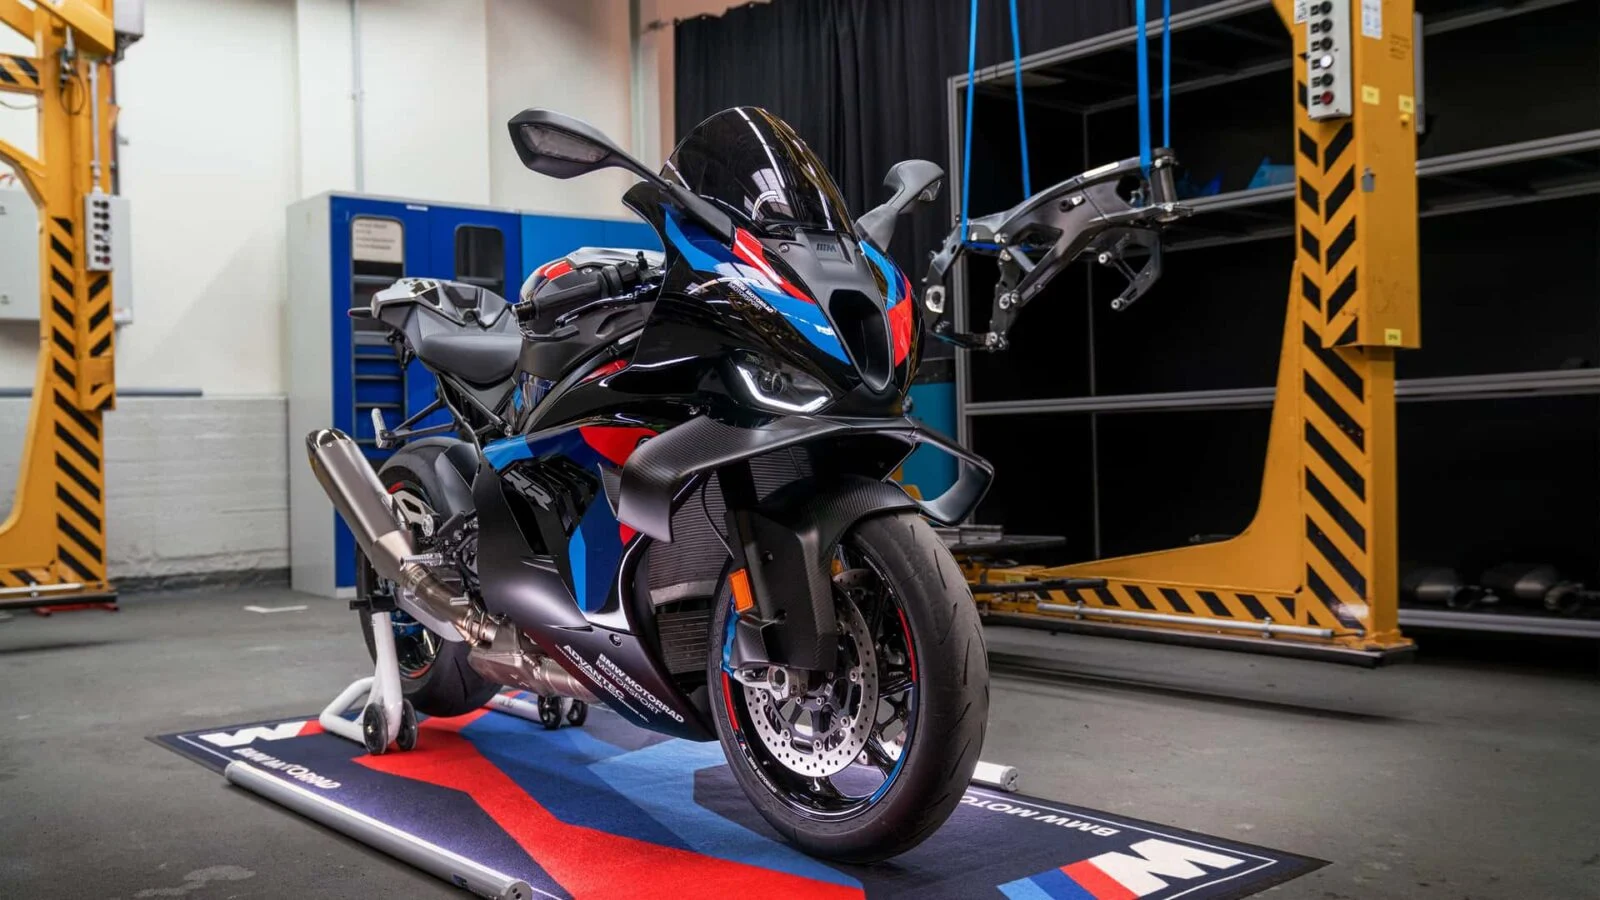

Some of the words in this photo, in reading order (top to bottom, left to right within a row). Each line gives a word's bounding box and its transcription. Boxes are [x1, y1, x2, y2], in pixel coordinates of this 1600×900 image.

[503, 469, 552, 511] RR
[563, 644, 625, 700] ADVANTEC
[595, 659, 662, 715] MOTORSPORT
[599, 653, 626, 678] BMW
[625, 675, 685, 723] MOTORRAD
[960, 795, 1041, 818] MOTO
[1033, 814, 1121, 837] BMW
